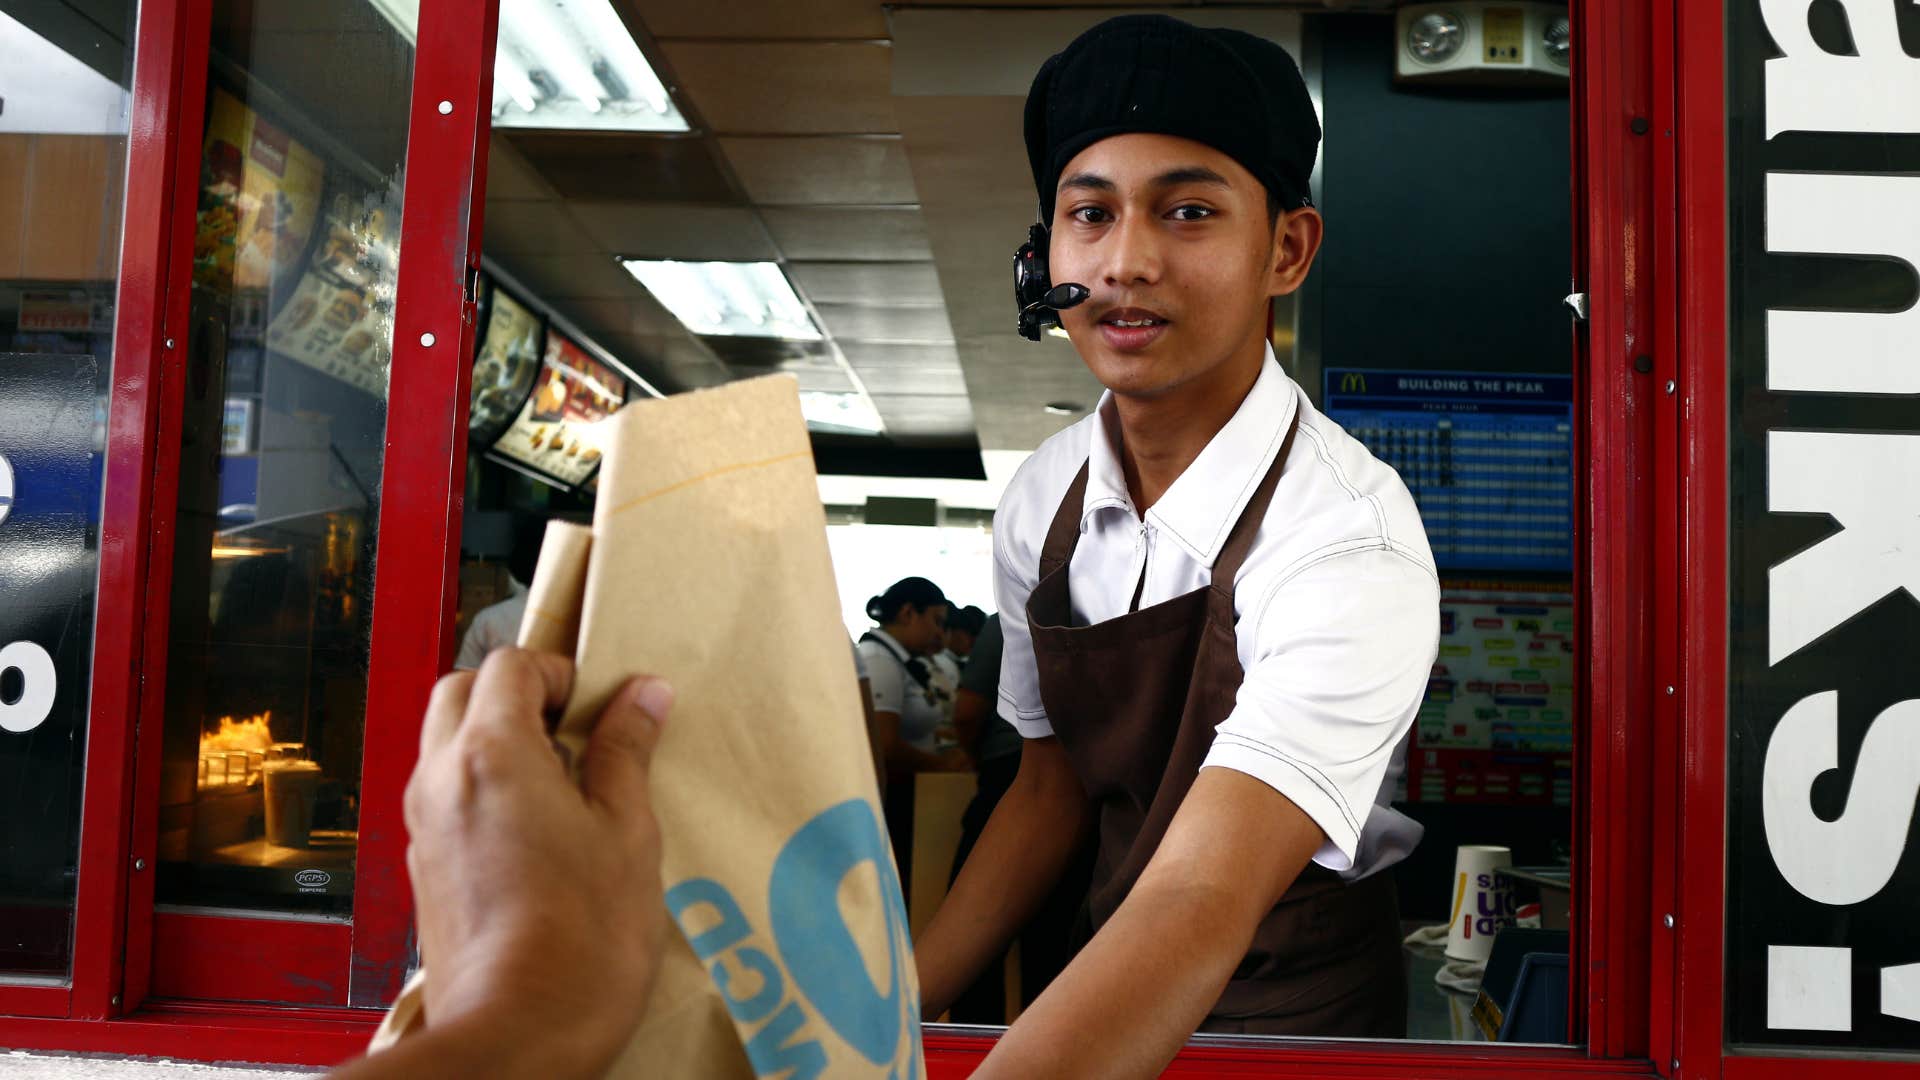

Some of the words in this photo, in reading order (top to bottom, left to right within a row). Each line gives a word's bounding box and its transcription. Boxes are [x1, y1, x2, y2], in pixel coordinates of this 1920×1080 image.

[1398, 379, 1469, 392] BUILDING
[1473, 381, 1501, 392] THE
[1505, 381, 1545, 393] PEAK
